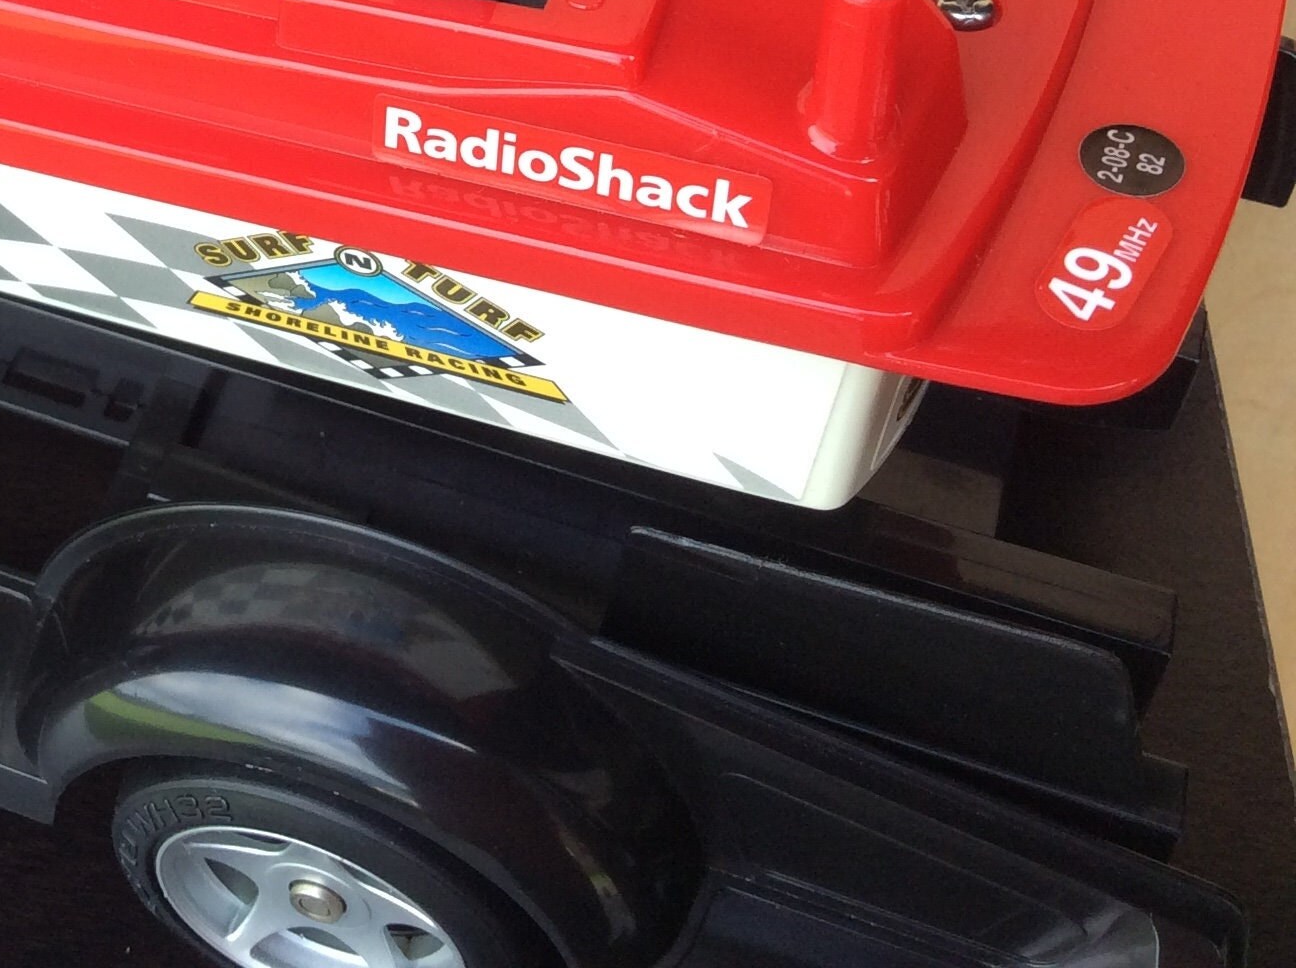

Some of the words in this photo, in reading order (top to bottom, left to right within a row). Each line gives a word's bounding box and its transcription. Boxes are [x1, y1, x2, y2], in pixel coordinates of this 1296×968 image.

[384, 106, 753, 229] RadioShack
[1136, 153, 1166, 175] 82
[193, 230, 314, 268] SURF
[401, 259, 545, 343] TURF
[224, 300, 390, 351] SHORELINE
[405, 345, 527, 388] RACING
